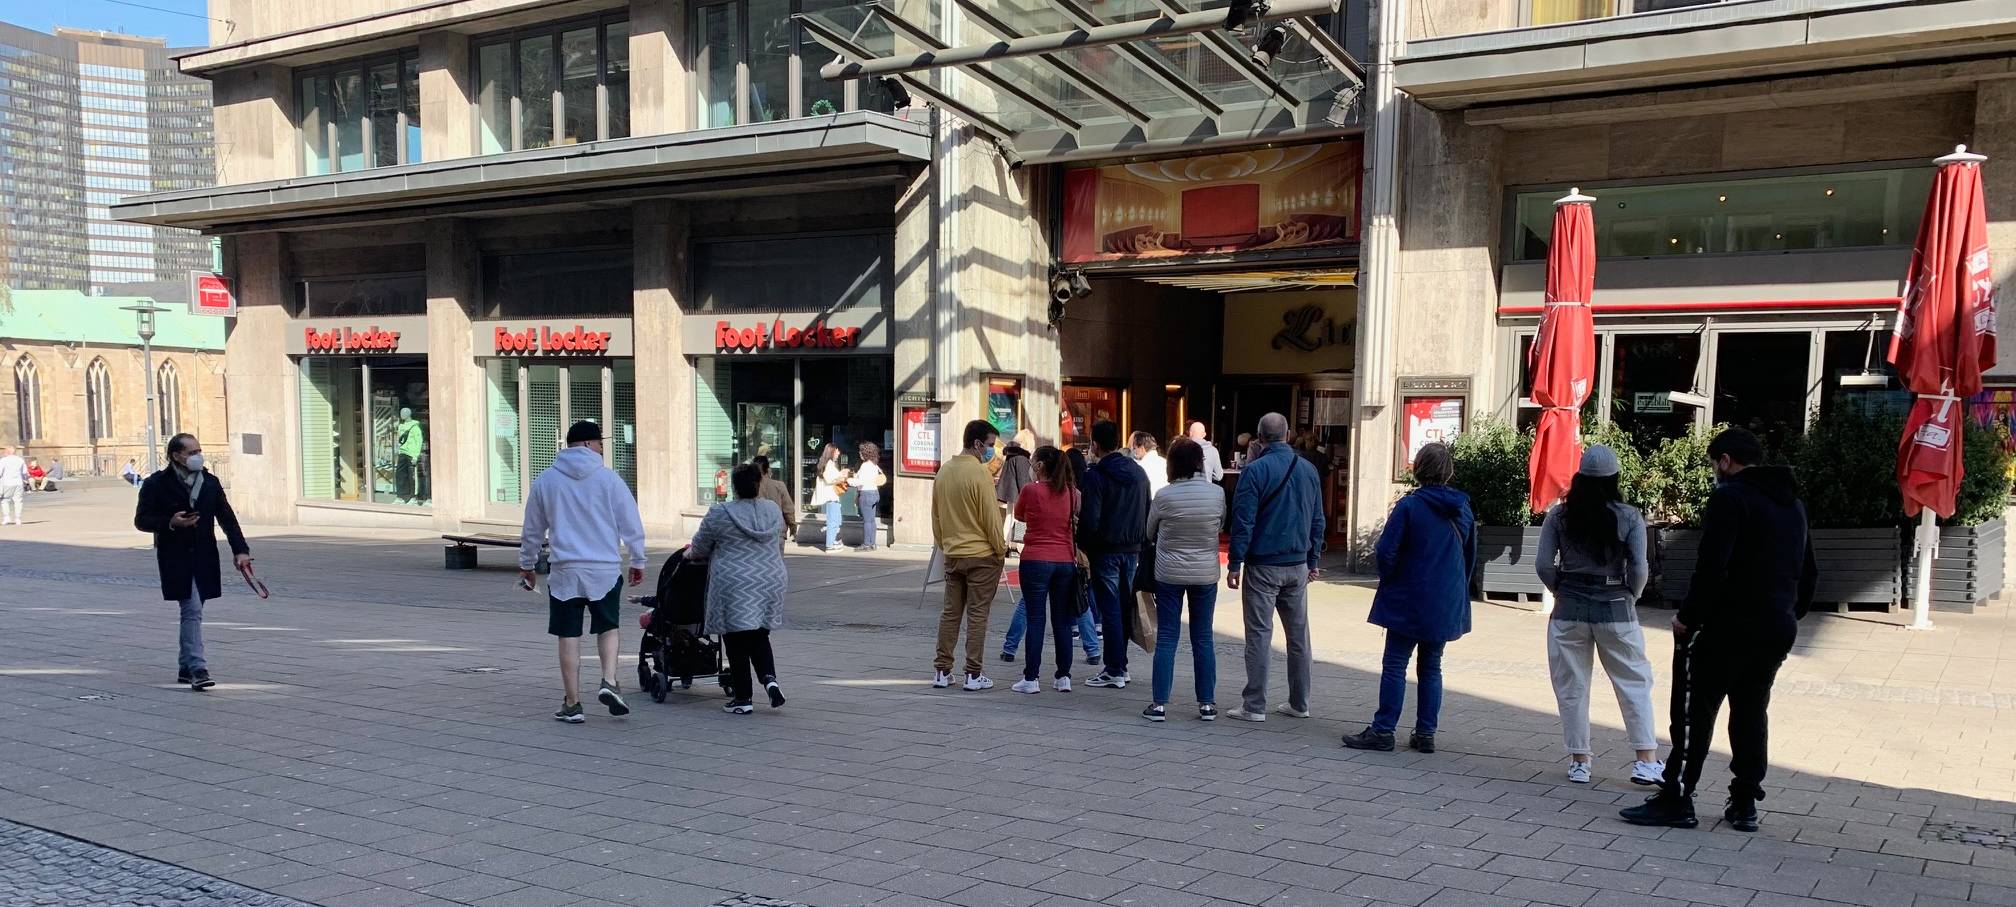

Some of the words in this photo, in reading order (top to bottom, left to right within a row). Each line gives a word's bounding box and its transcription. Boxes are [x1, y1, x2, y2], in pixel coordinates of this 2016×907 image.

[304, 327, 342, 351] Foot
[343, 325, 400, 351] Locker
[495, 326, 537, 352] Foot
[541, 324, 611, 352] Locker
[716, 320, 767, 350] Foot
[773, 319, 861, 350] Locker
[917, 431, 932, 439] CTL
[1425, 428, 1446, 439] CTL
